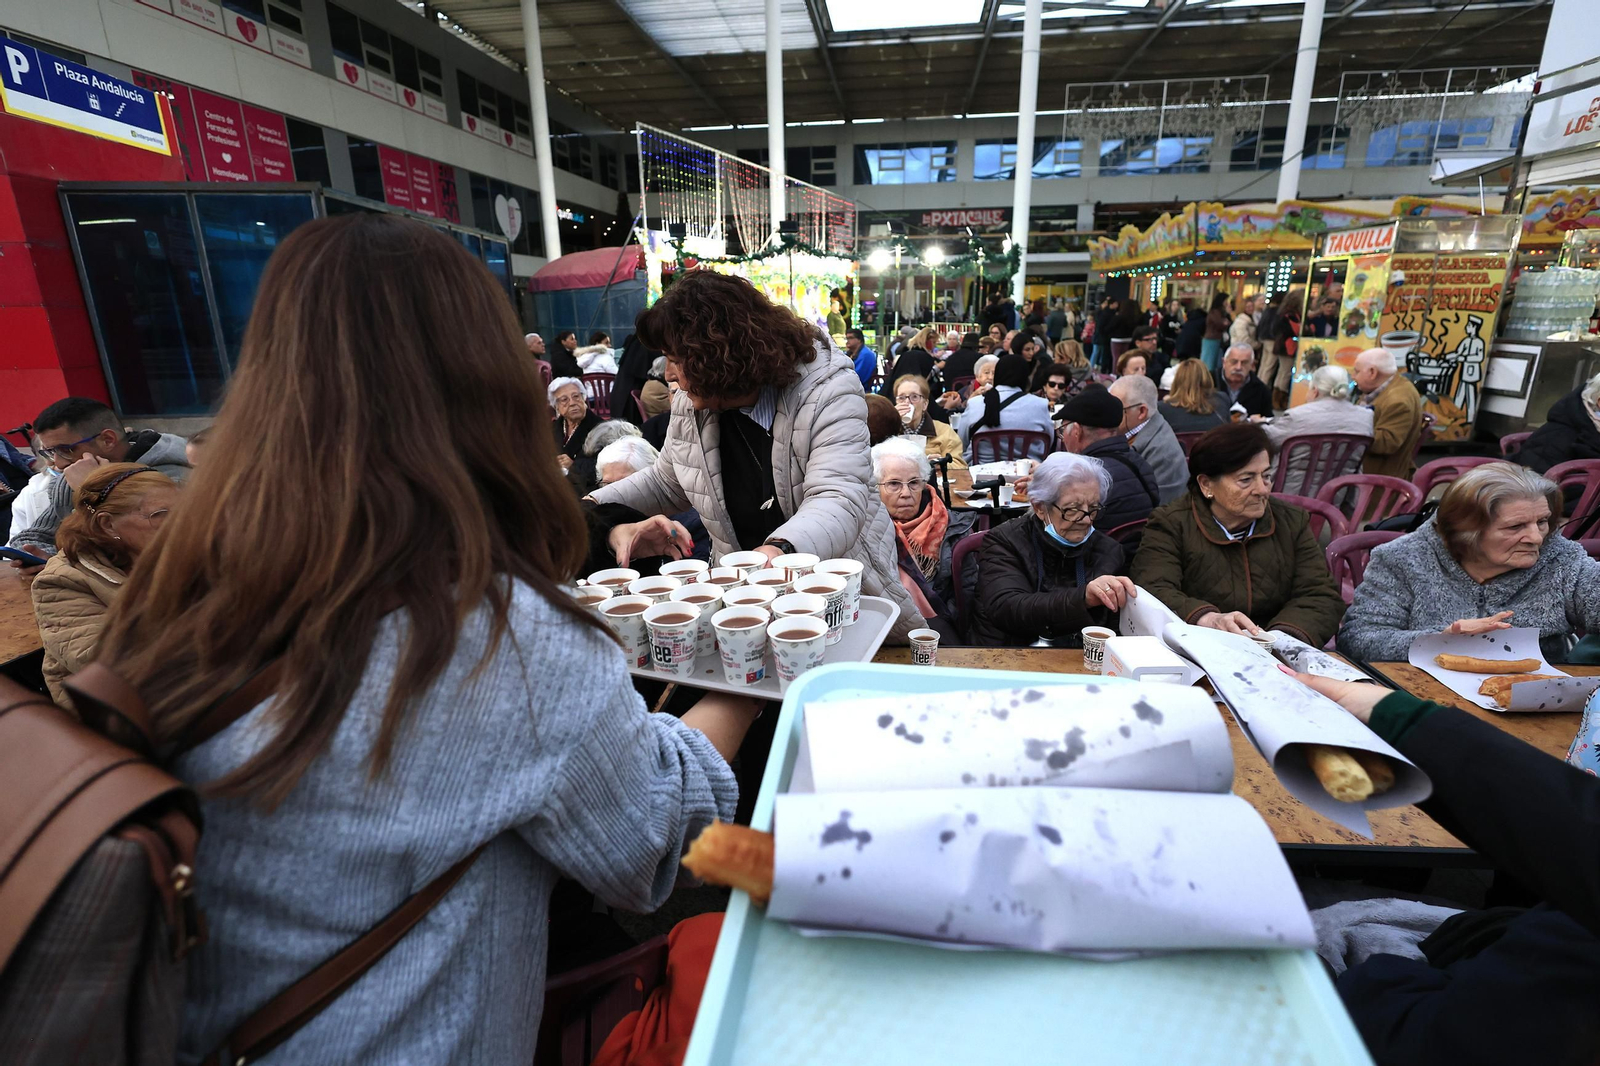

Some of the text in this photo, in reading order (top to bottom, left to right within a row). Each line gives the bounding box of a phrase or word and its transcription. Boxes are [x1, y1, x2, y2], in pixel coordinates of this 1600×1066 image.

[4, 45, 30, 86] P
[54, 62, 90, 86] Plaza
[1563, 112, 1599, 136] LOS
[1328, 226, 1394, 253] TAQUILLA
